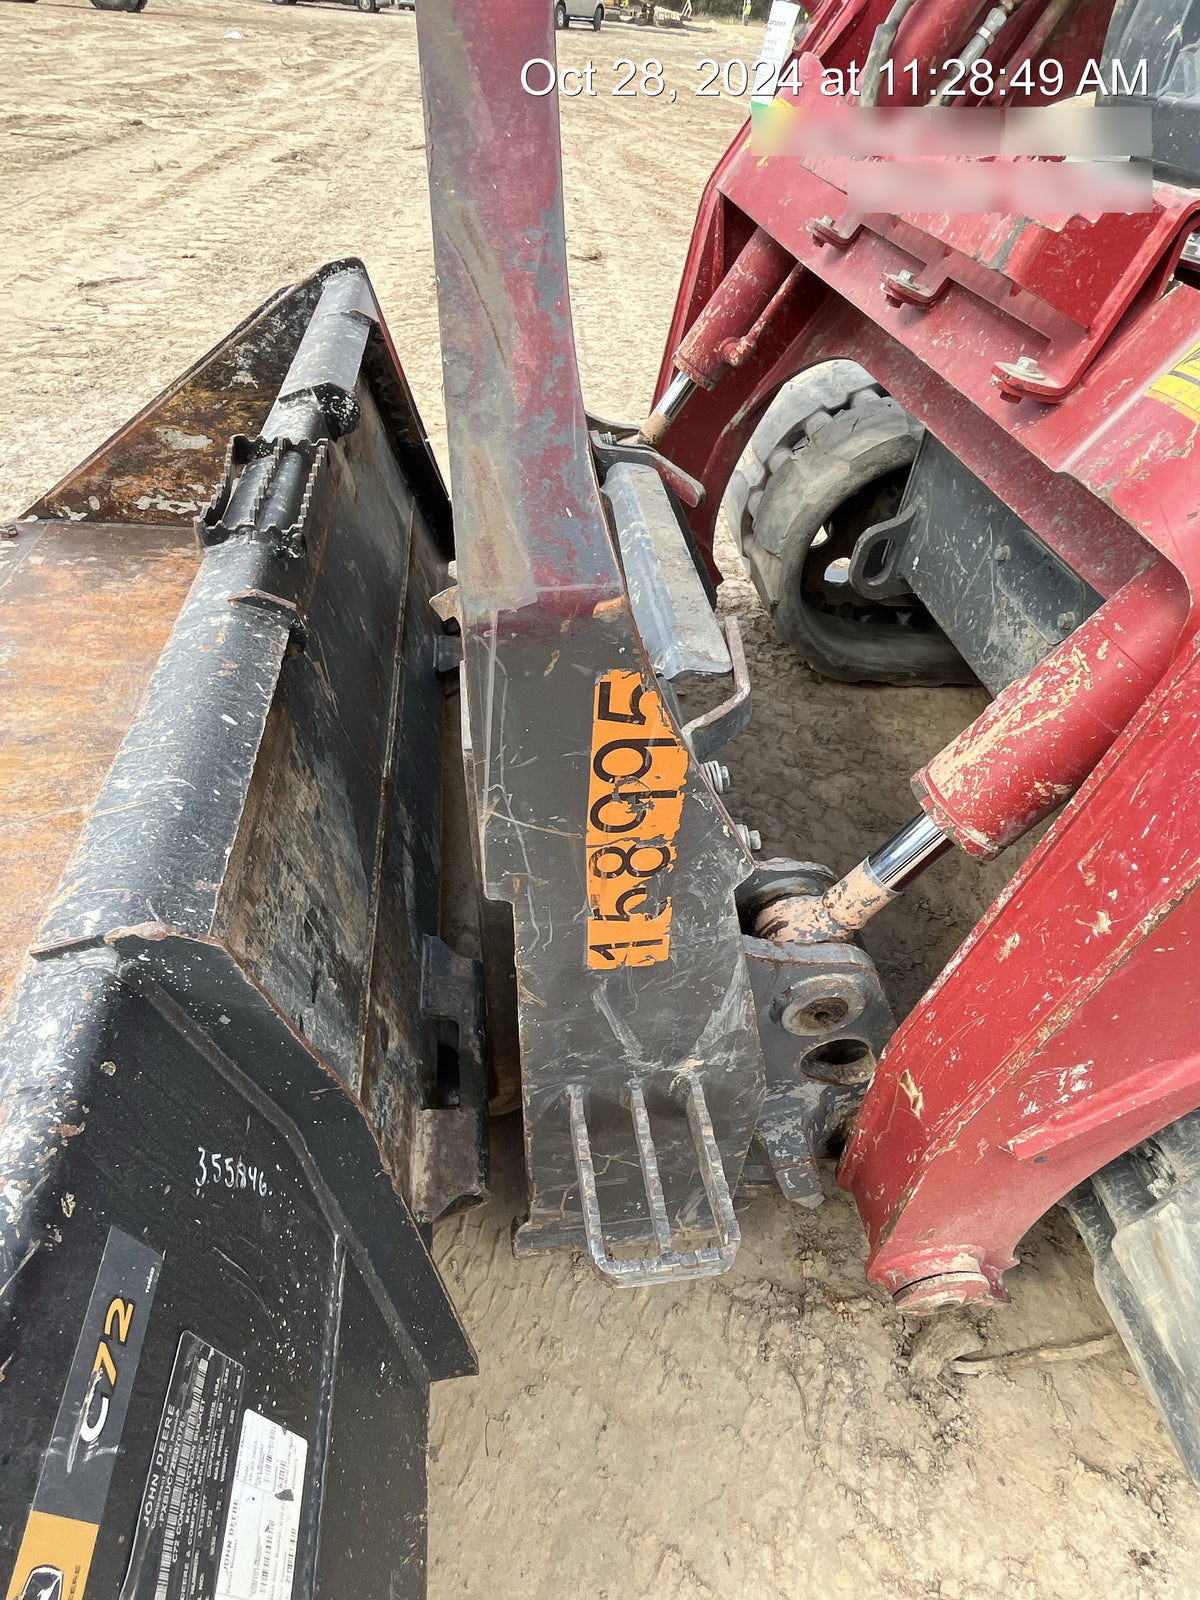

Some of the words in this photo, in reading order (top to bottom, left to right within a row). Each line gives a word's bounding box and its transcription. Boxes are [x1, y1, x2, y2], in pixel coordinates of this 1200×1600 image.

[588, 680, 680, 962] 158995
[195, 1146, 268, 1197] 355846
[80, 1297, 136, 1443] C72
[213, 1377, 221, 1397] USA
[143, 1473, 160, 1527] JOHN
[156, 1404, 175, 1466] DEERE
[193, 1436, 204, 1475] MEXICO
[213, 1459, 221, 1481] MAX
[172, 1540, 180, 1563] C72
[176, 1444, 196, 1535] CONSTRUCTION
[193, 1398, 206, 1441] BUCKET
[191, 1477, 197, 1489] IN
[185, 1492, 194, 1524] MADE
[223, 1540, 233, 1570] JOHN
